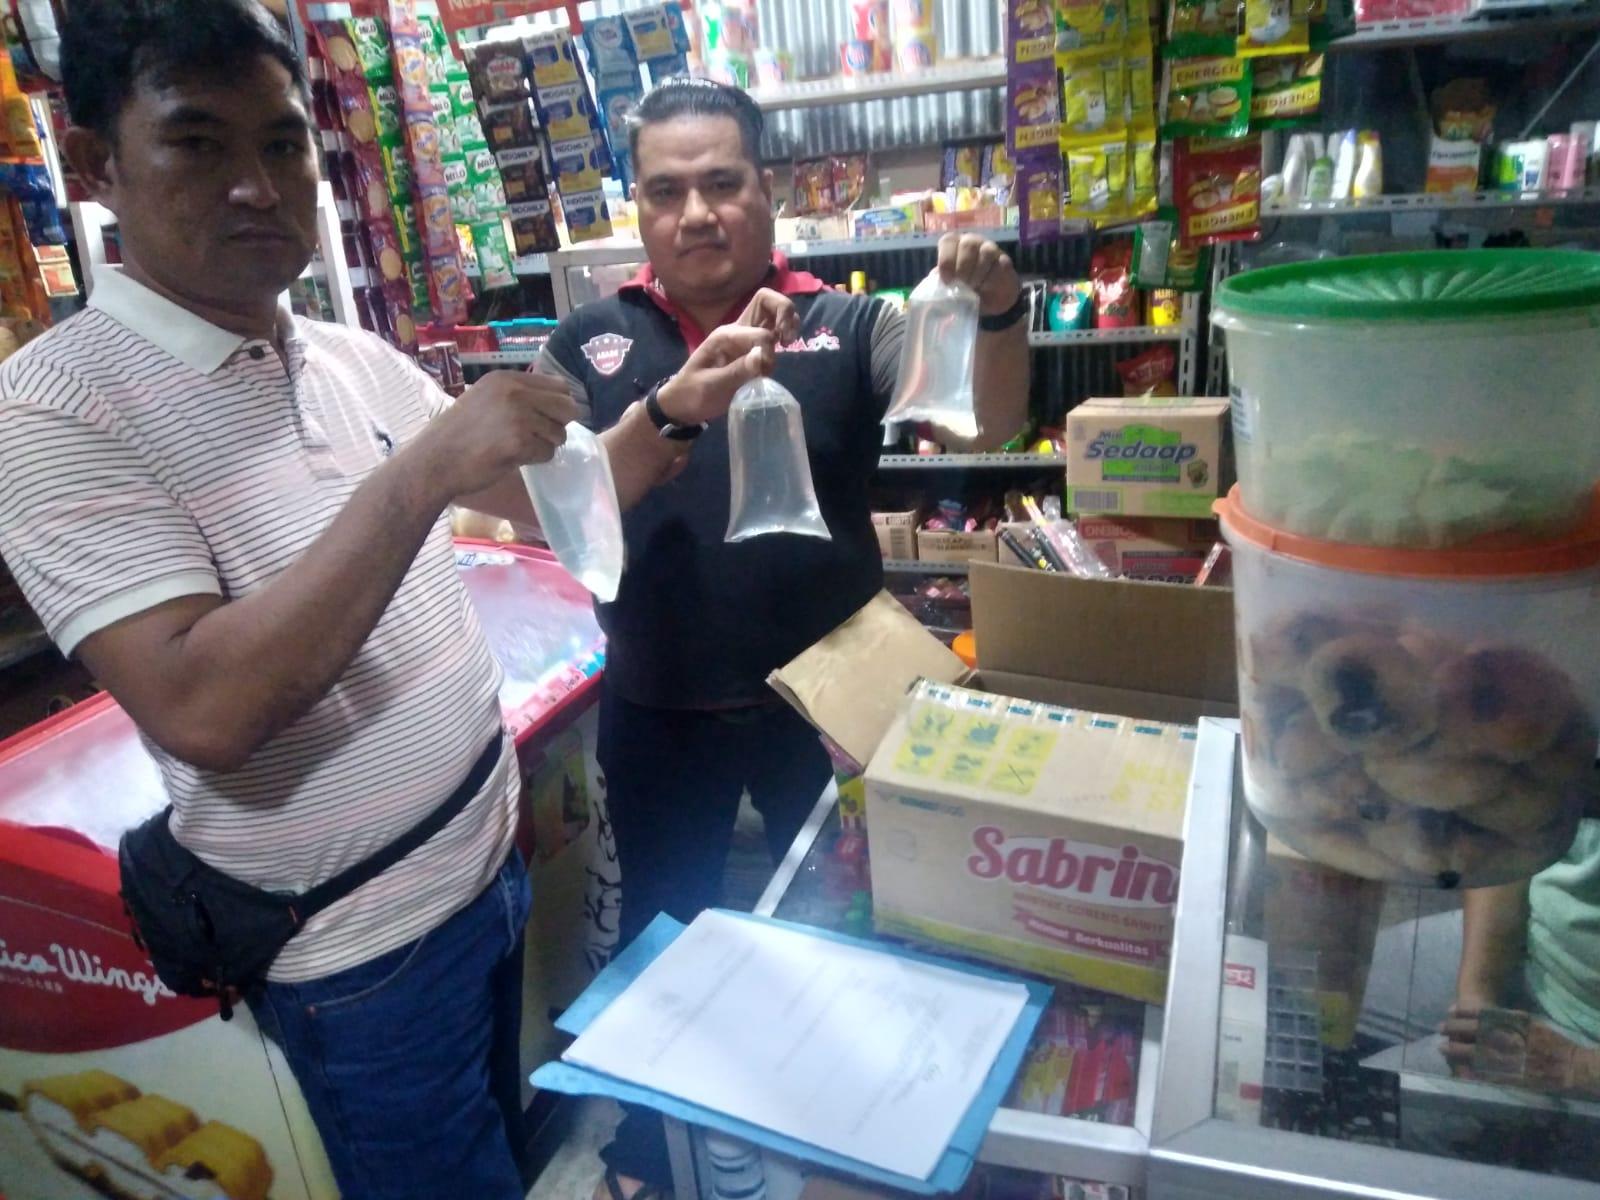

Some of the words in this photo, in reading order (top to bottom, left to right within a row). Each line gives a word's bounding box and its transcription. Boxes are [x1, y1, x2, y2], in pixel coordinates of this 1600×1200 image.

[1086, 440, 1198, 465] Sedaap
[967, 825, 1178, 904] Sabrin
[0, 940, 57, 974] ico
[1075, 933, 1150, 957] Berkualitas
